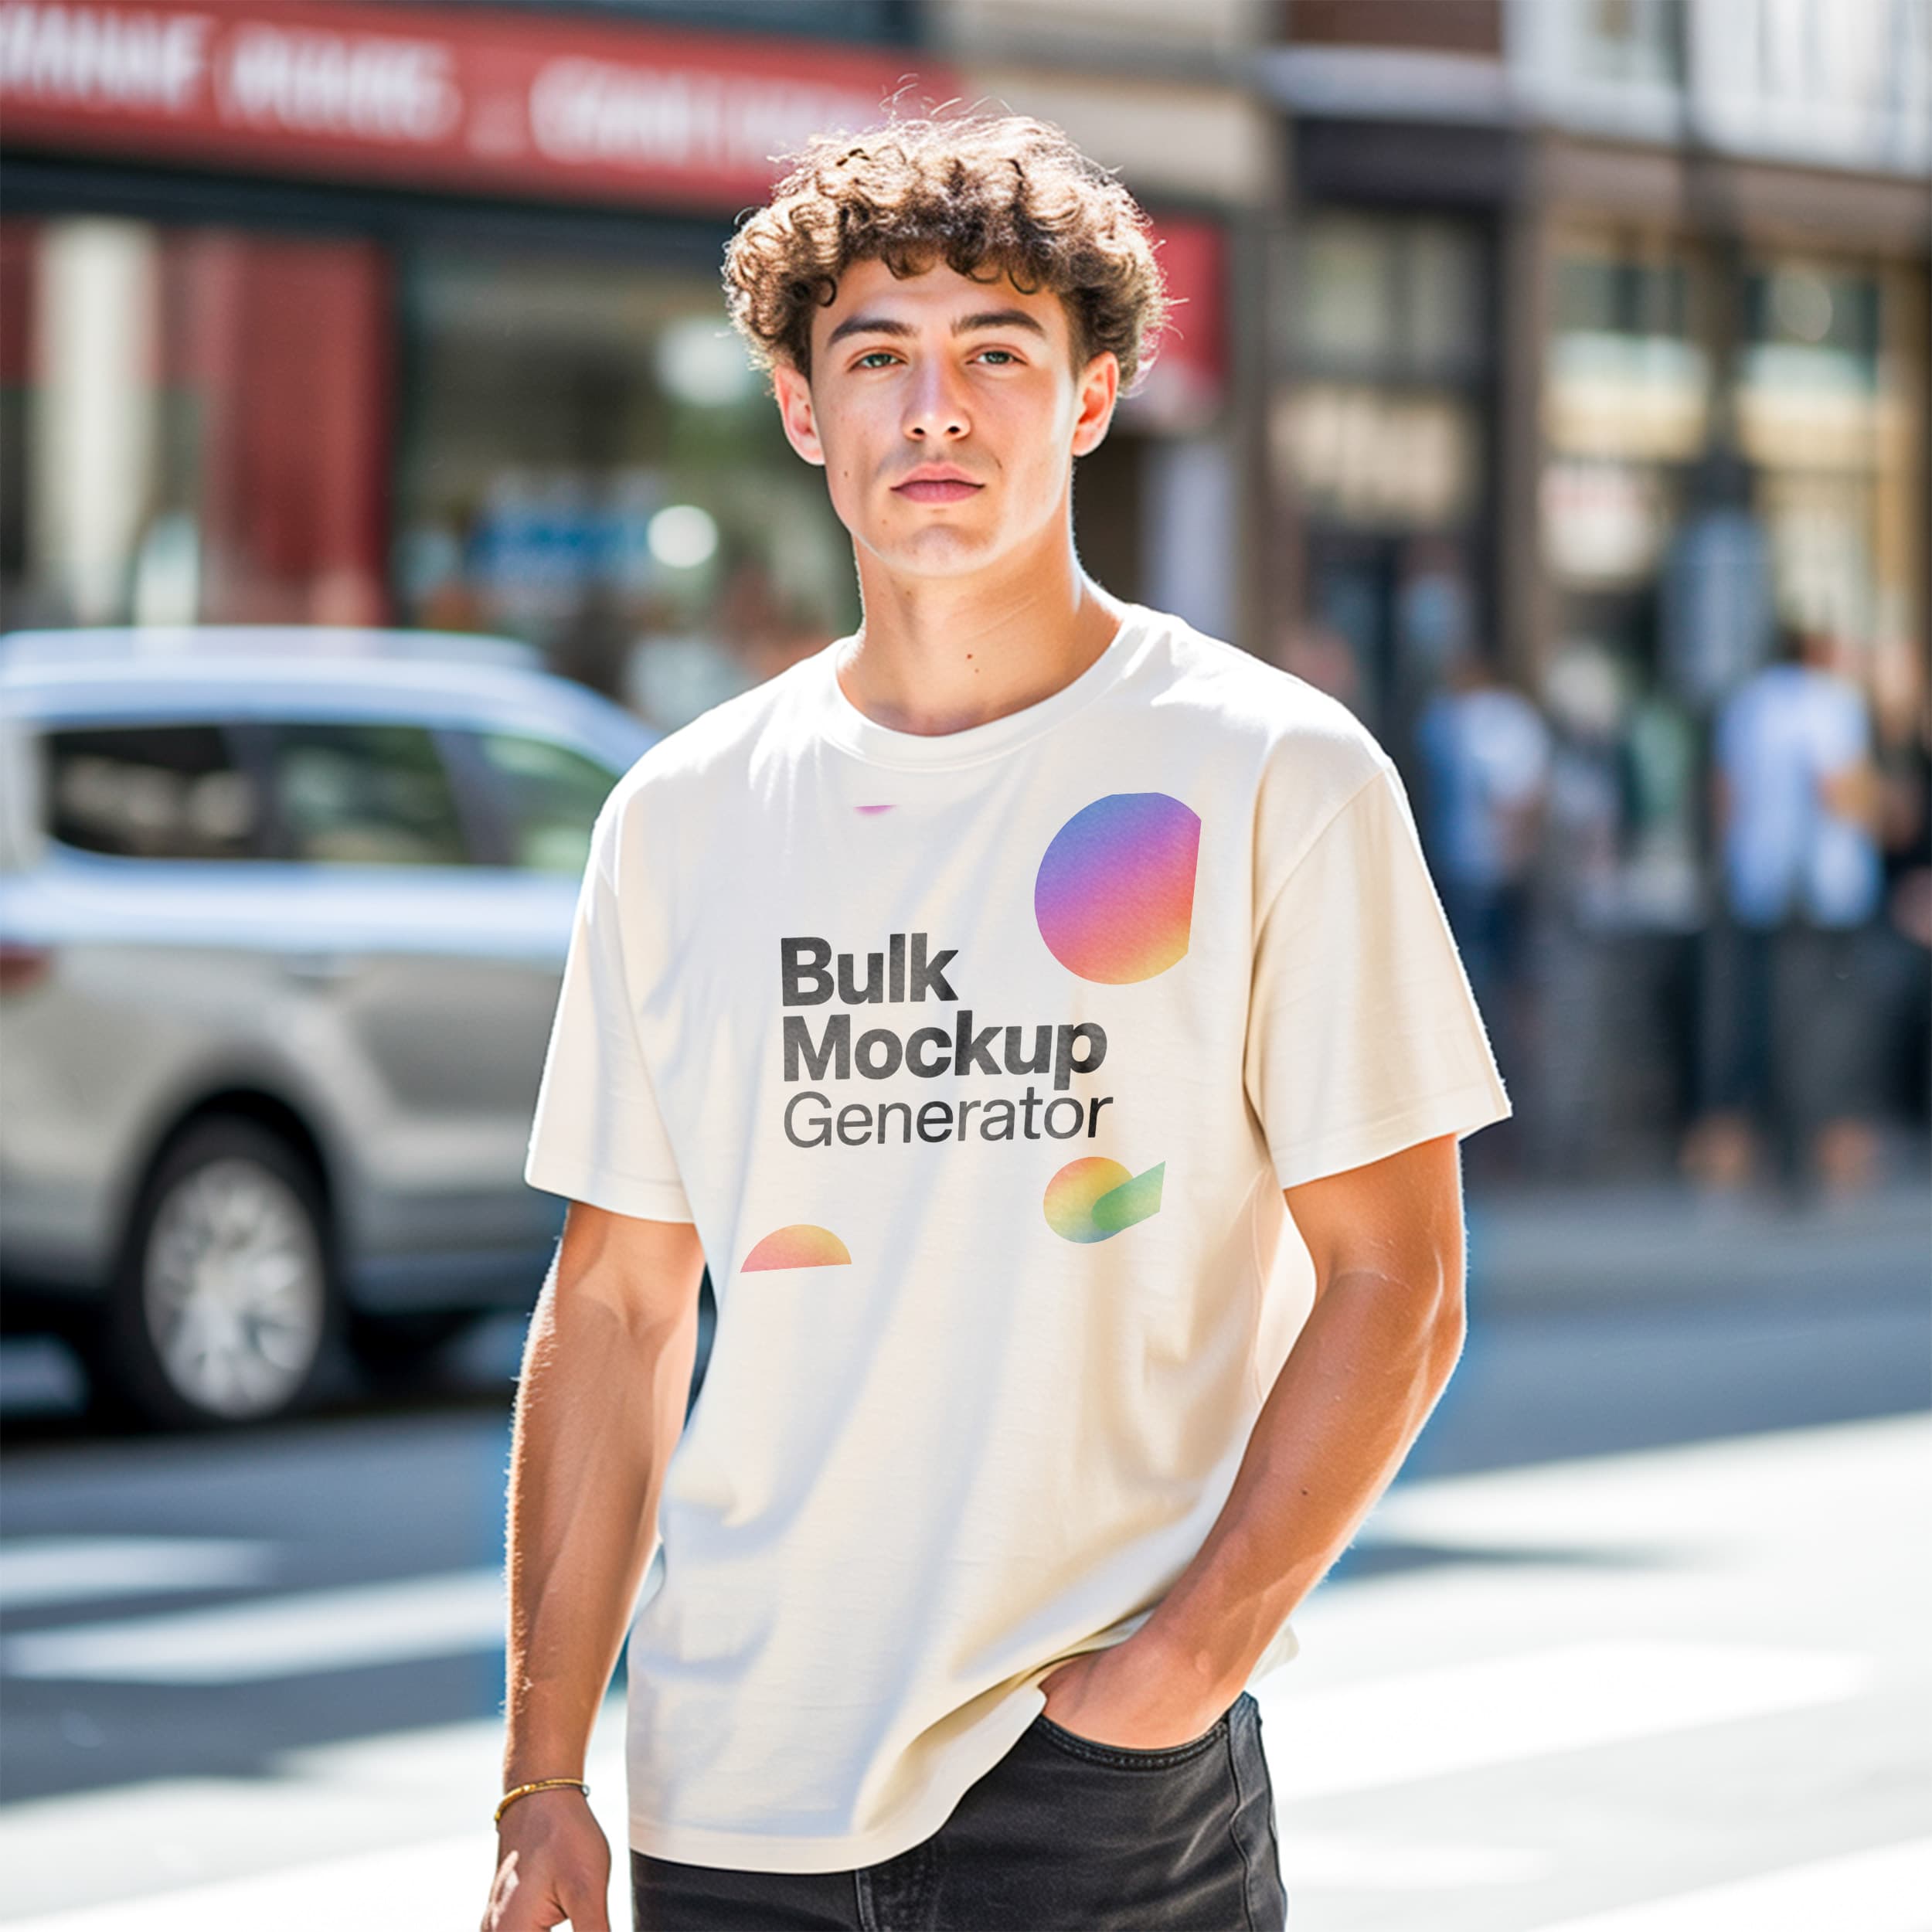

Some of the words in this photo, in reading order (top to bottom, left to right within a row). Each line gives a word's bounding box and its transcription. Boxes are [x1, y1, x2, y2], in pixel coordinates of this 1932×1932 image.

[781, 932, 959, 1007] Bulk
[783, 1009, 1107, 1091] Mockup
[784, 1087, 1114, 1148] Generator
